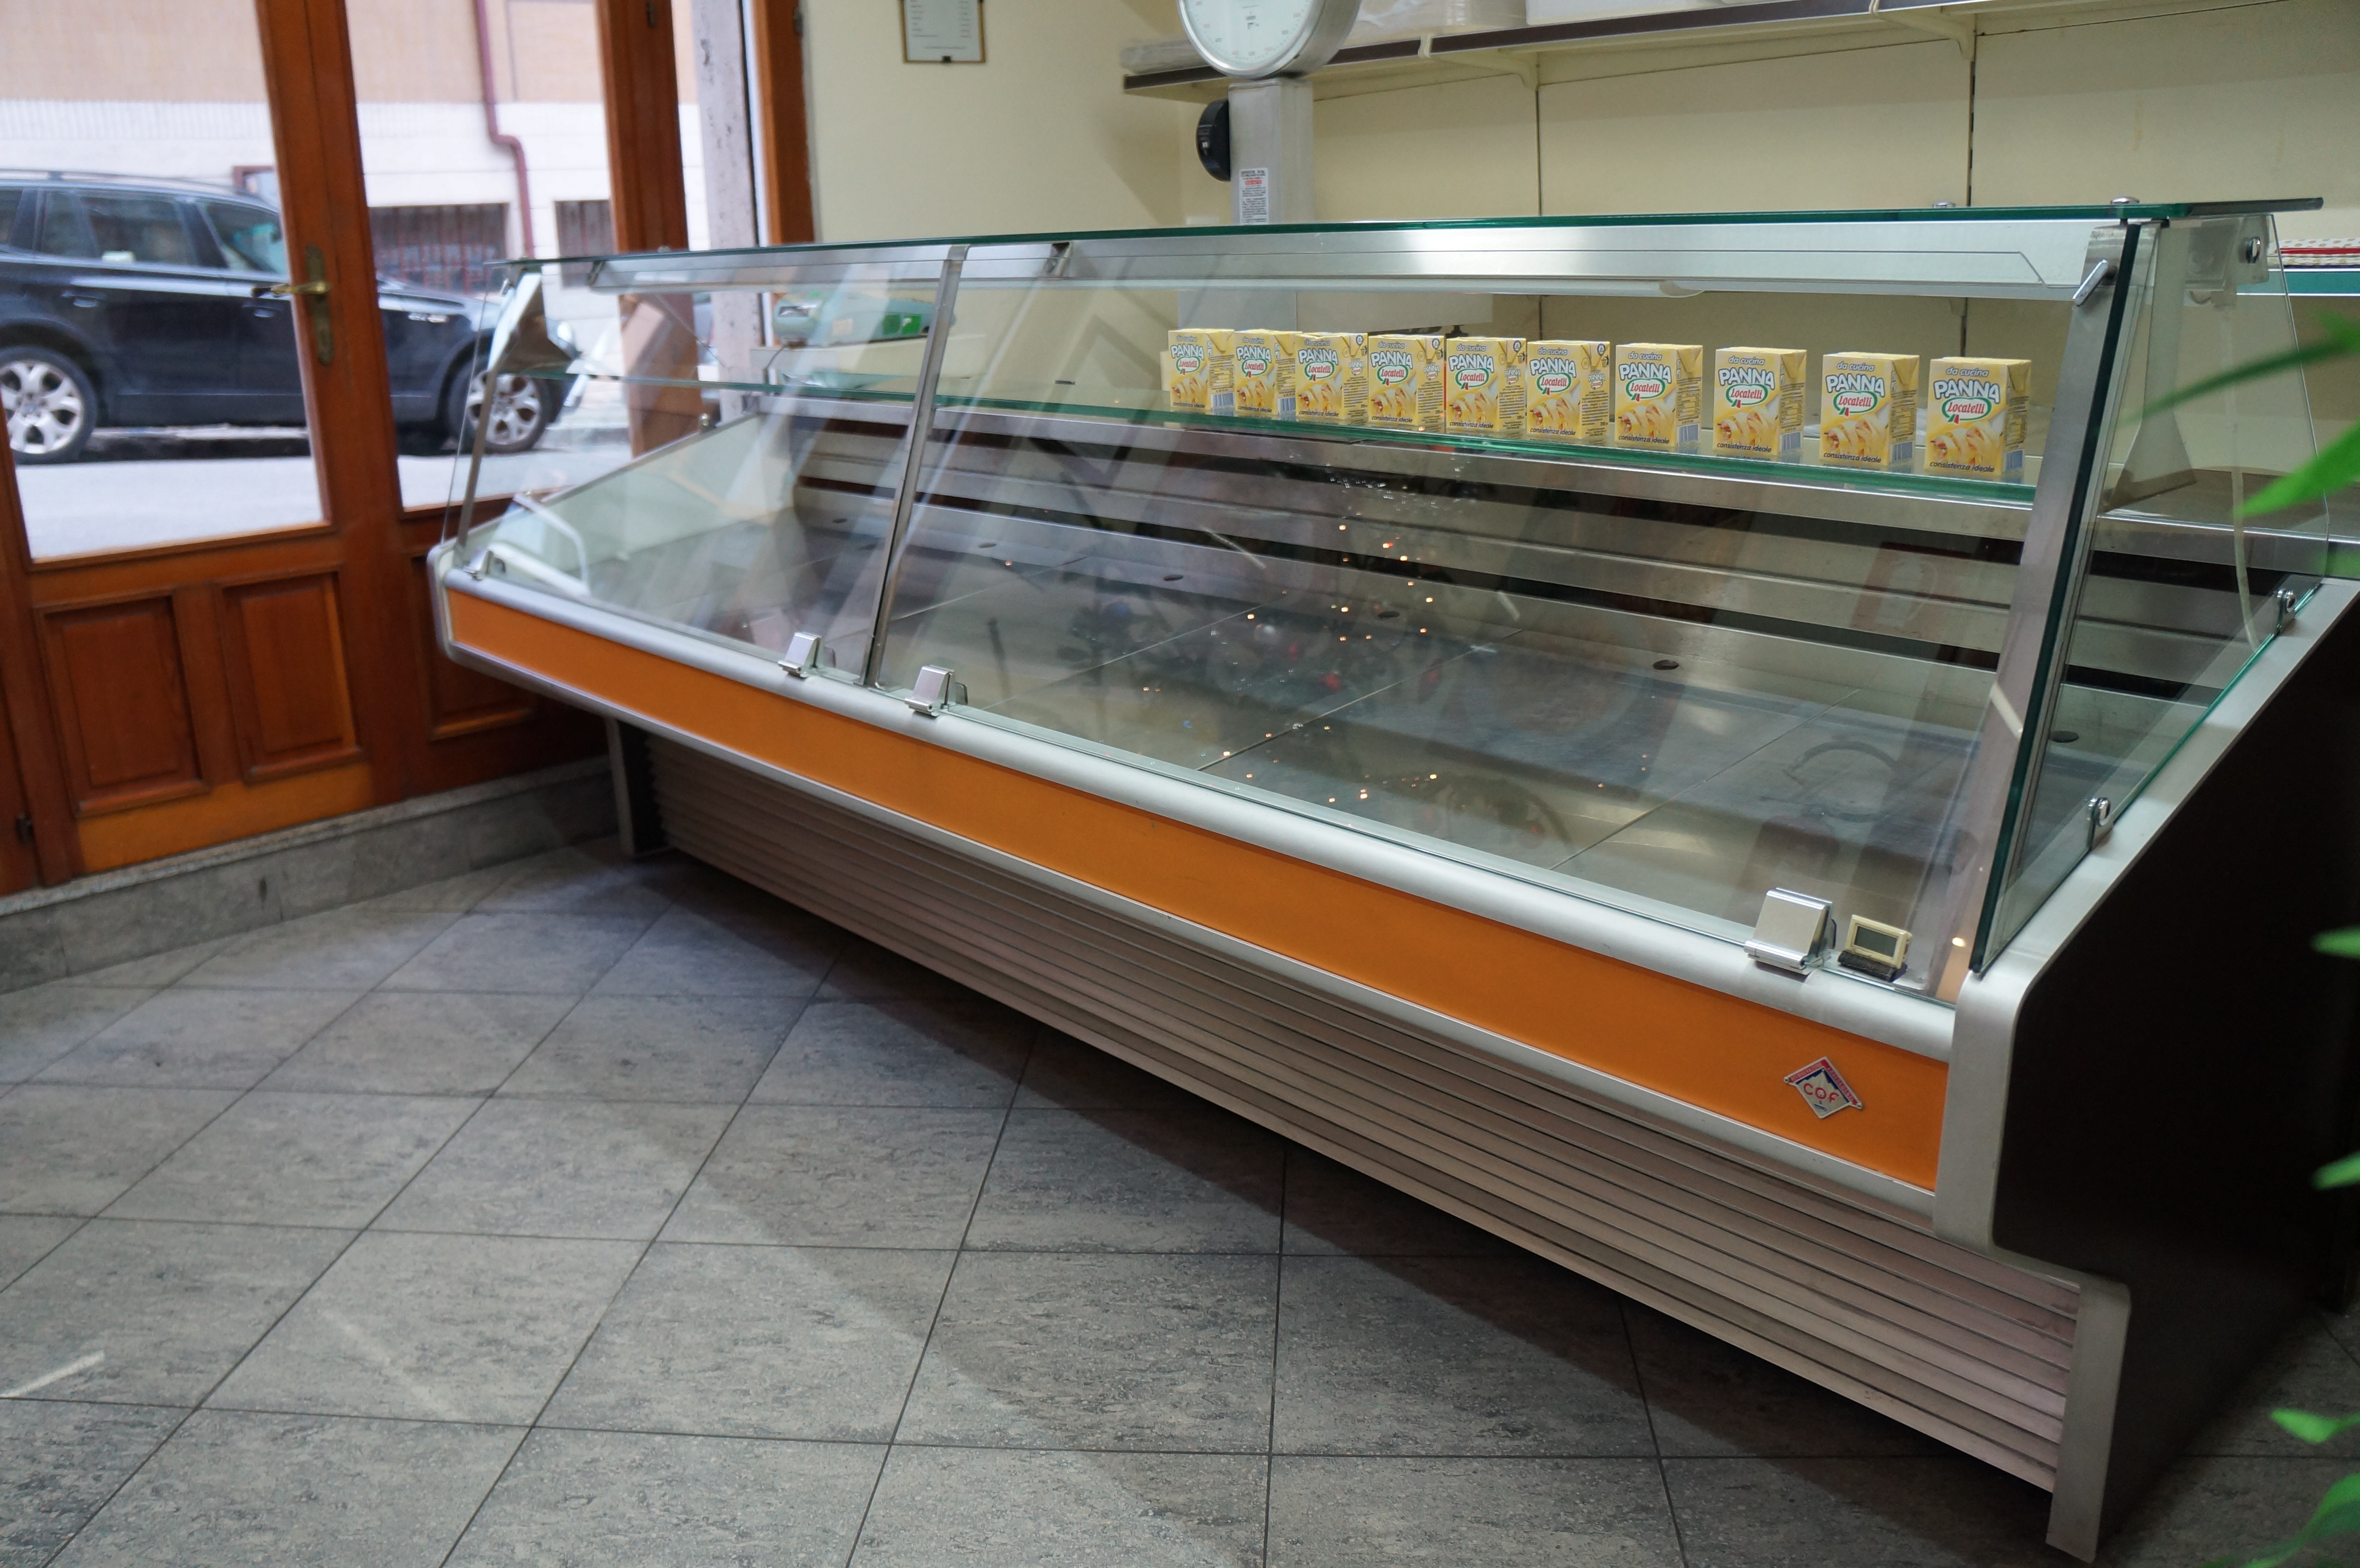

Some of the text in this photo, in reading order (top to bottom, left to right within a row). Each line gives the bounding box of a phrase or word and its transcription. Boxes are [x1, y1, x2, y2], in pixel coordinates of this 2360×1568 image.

[1170, 343, 1204, 360] PANNA
[1236, 345, 1271, 363] PANNA
[1298, 348, 1339, 365] PANNA
[1639, 352, 1662, 360] cucina
[1370, 351, 1413, 369] PANNA
[1448, 354, 1494, 373] PANNA
[1729, 355, 1765, 365] da cucina
[1424, 365, 1440, 373] PANNA
[1530, 357, 1576, 378] PANNA
[1837, 361, 1874, 371] da cucina
[1946, 366, 1989, 377] da cucina
[1381, 369, 1404, 378] Locatelli
[1460, 372, 1485, 381] Locatelli
[1588, 374, 1605, 382] PANNA
[1619, 362, 1672, 384] PANNA
[1541, 377, 1567, 387] Locatelli
[1718, 367, 1775, 391] PANNA
[1630, 383, 1660, 393] Locatelli
[1826, 373, 1885, 398] PANNA
[1731, 388, 1762, 399] Locatelli
[1933, 379, 2001, 404] PANNA
[1838, 396, 1872, 407] Locatelli
[1947, 402, 1984, 414] Locatelli
[1652, 436, 1669, 444] ideale
[1717, 442, 1771, 453] consistenza ideale
[1824, 453, 1881, 463] consistenza ideale
[1930, 462, 1995, 472] consistenza ideale
[1803, 1083, 1840, 1102] COF
